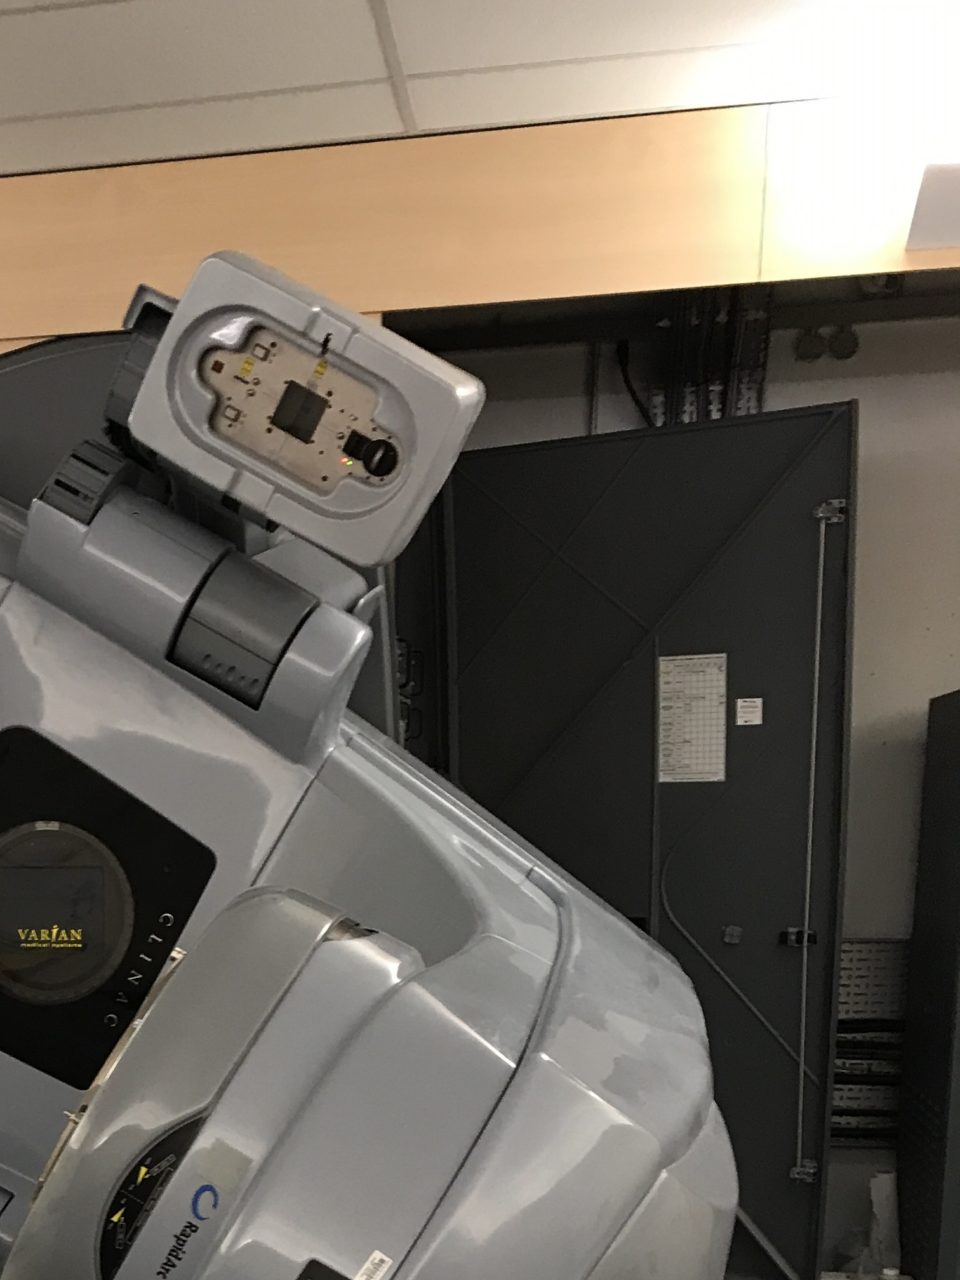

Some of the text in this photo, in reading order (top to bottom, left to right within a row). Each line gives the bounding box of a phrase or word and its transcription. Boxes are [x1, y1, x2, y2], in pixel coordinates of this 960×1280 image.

[17, 924, 82, 942] VARIAN
[104, 913, 174, 1027] CLINAC
[156, 1221, 199, 1280] RapidArc
